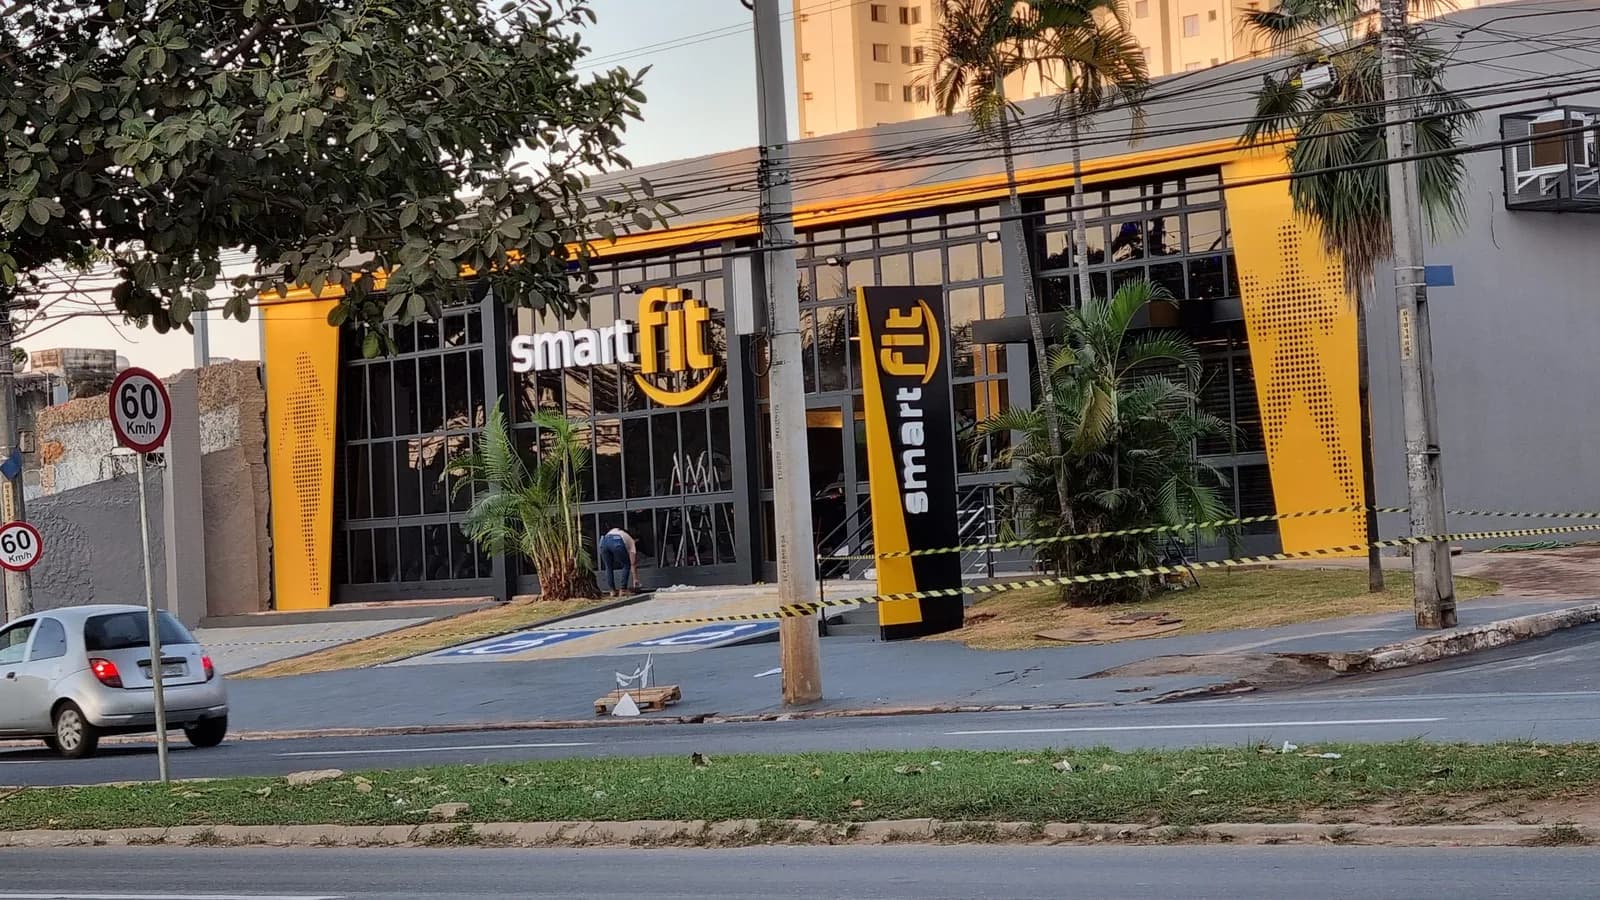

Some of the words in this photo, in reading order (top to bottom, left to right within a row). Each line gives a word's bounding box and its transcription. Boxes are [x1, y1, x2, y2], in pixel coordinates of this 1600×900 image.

[511, 319, 634, 373] smart
[638, 286, 714, 374] fit
[881, 307, 926, 375] fit
[121, 383, 158, 420] 60
[126, 421, 156, 434] Km/h
[896, 387, 929, 514] smart
[1, 530, 31, 554] 60
[8, 551, 32, 563] Km/h
